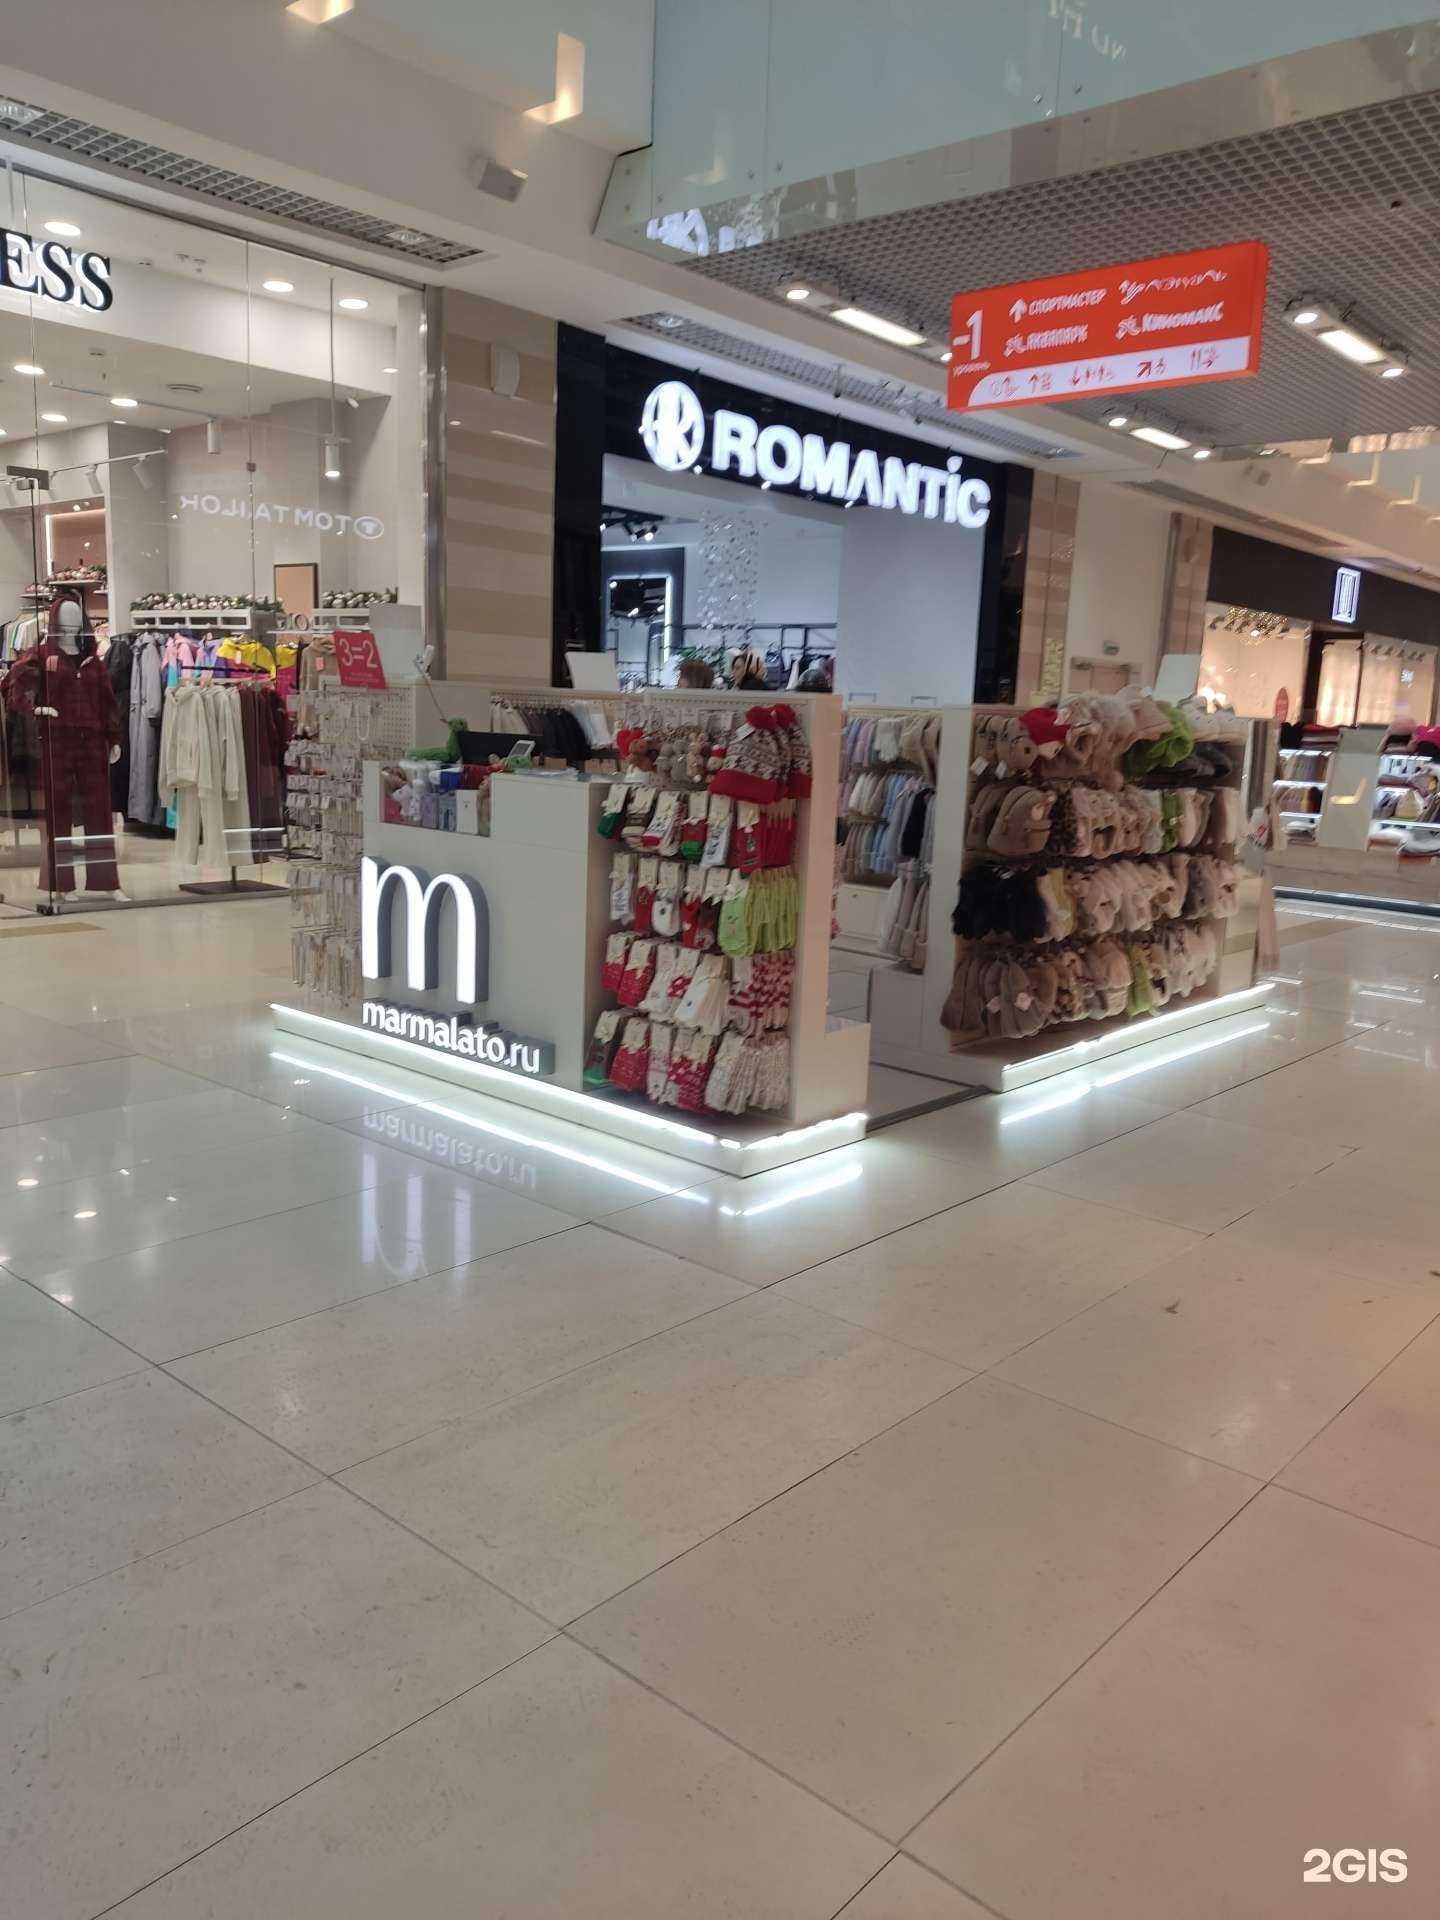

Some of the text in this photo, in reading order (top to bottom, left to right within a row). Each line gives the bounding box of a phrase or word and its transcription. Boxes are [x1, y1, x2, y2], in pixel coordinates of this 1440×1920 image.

[0, 227, 113, 311] ESS
[339, 638, 379, 668] 3=2
[362, 1001, 541, 1074] marmalato.ru
